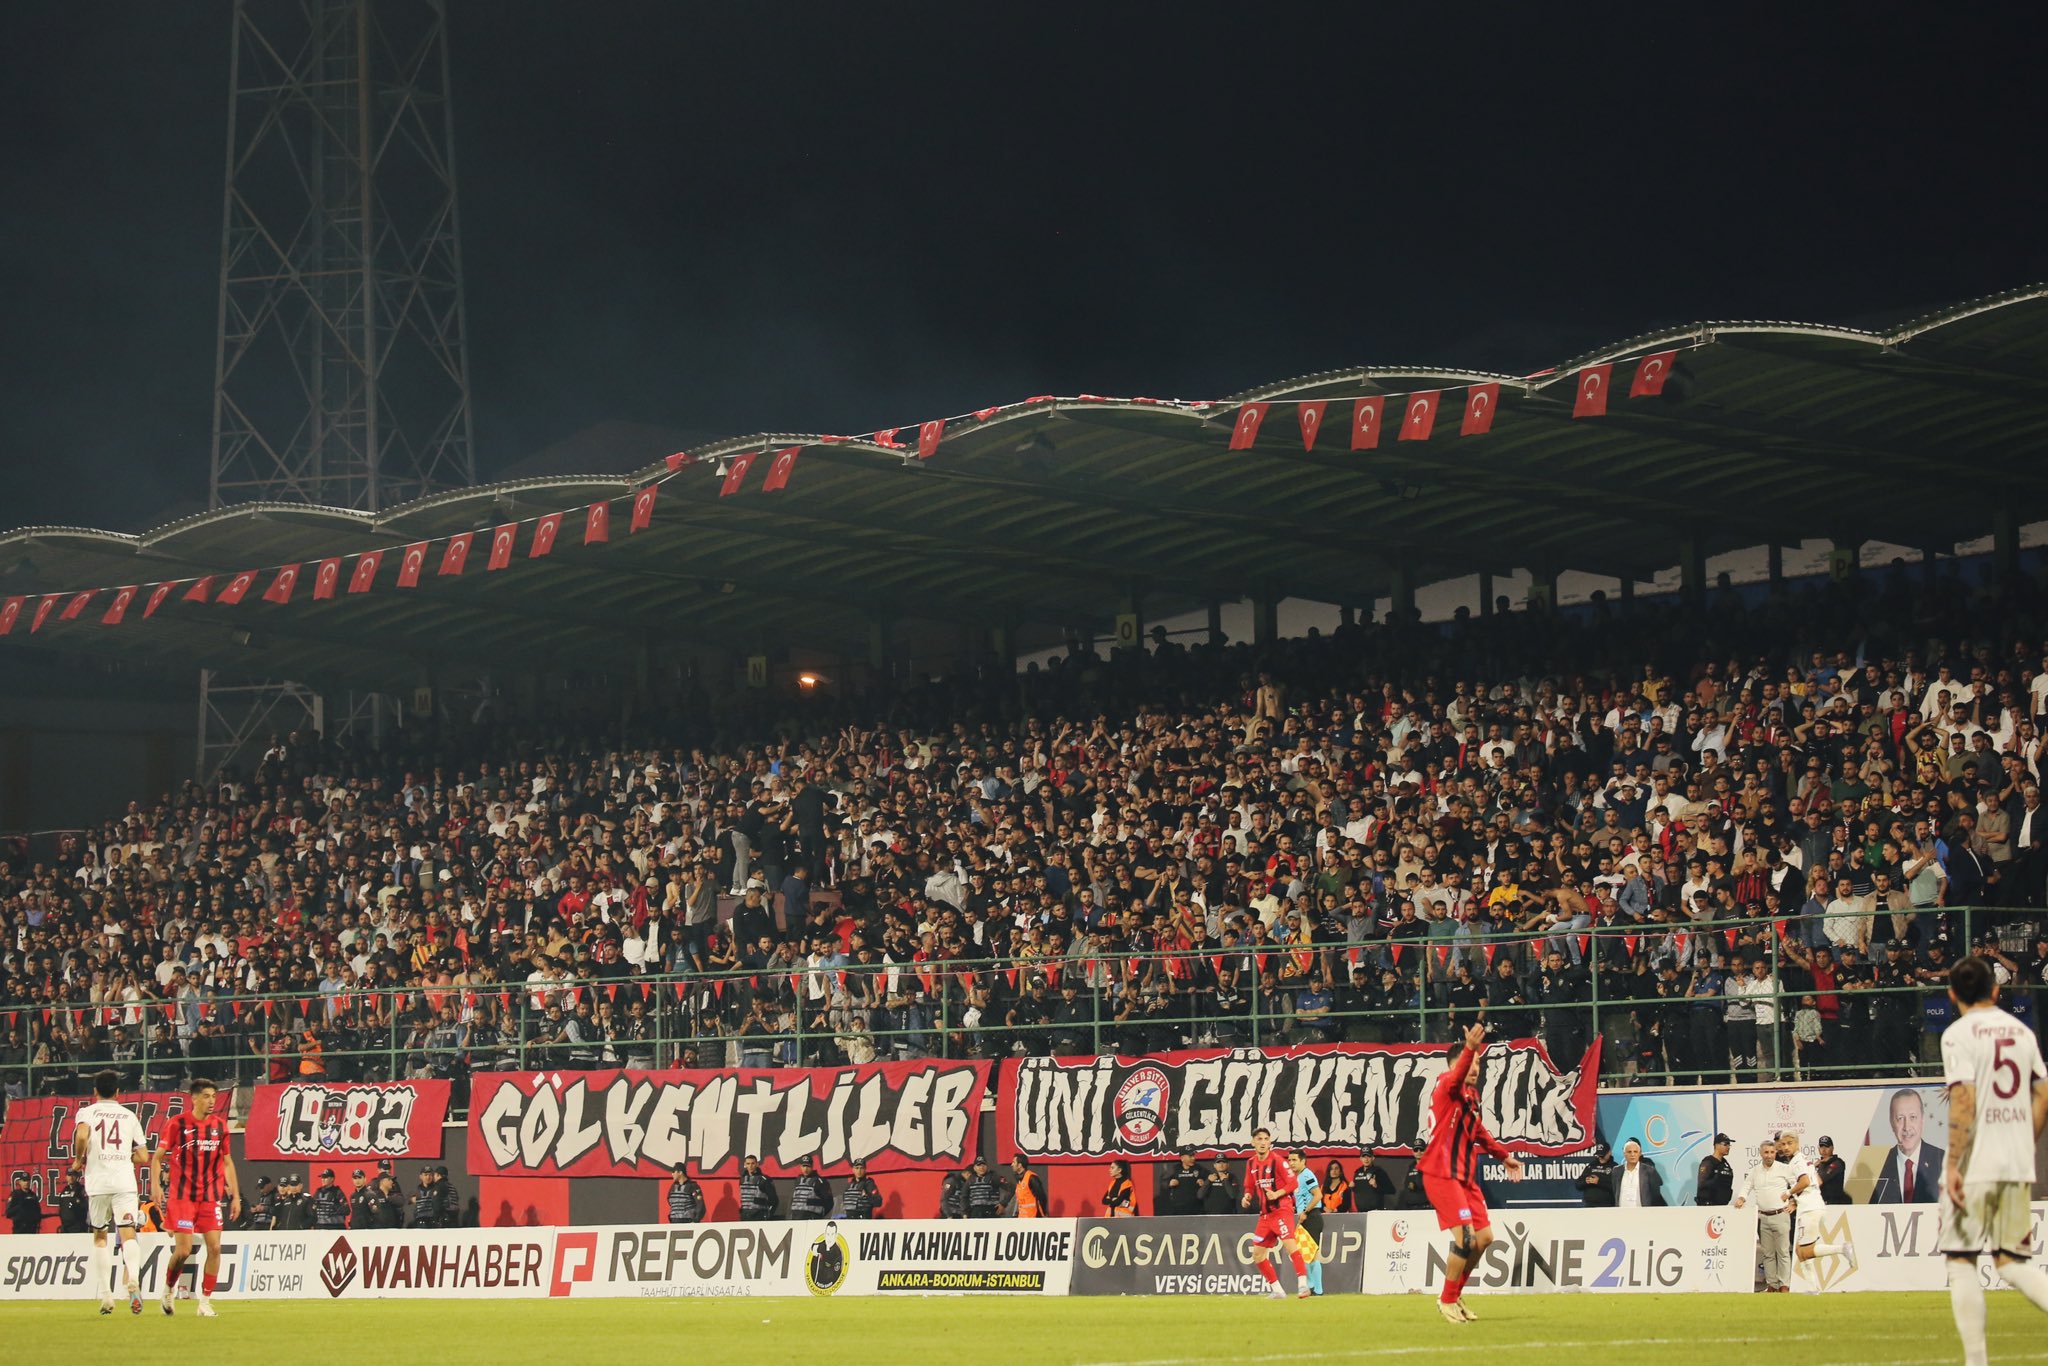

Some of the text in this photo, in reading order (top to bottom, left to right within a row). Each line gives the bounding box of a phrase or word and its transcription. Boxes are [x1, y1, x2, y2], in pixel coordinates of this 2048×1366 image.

[1992, 1038, 2021, 1099] 5
[274, 1084, 418, 1156] 1982
[480, 1068, 976, 1169] GÖLKENTLİLER
[1018, 1057, 1114, 1152] ÜNİ
[1985, 1107, 2026, 1124] ERCAN
[95, 1119, 122, 1150] 14
[362, 1243, 542, 1288] WANHABER
[608, 1228, 793, 1282] REFORM
[859, 1231, 1071, 1261] VAN KAHVALTI LOUNGE
[1082, 1226, 1362, 1269] CASABA GRUP
[3, 1250, 89, 1291] sports
[250, 1270, 303, 1292] ÜST YAPI
